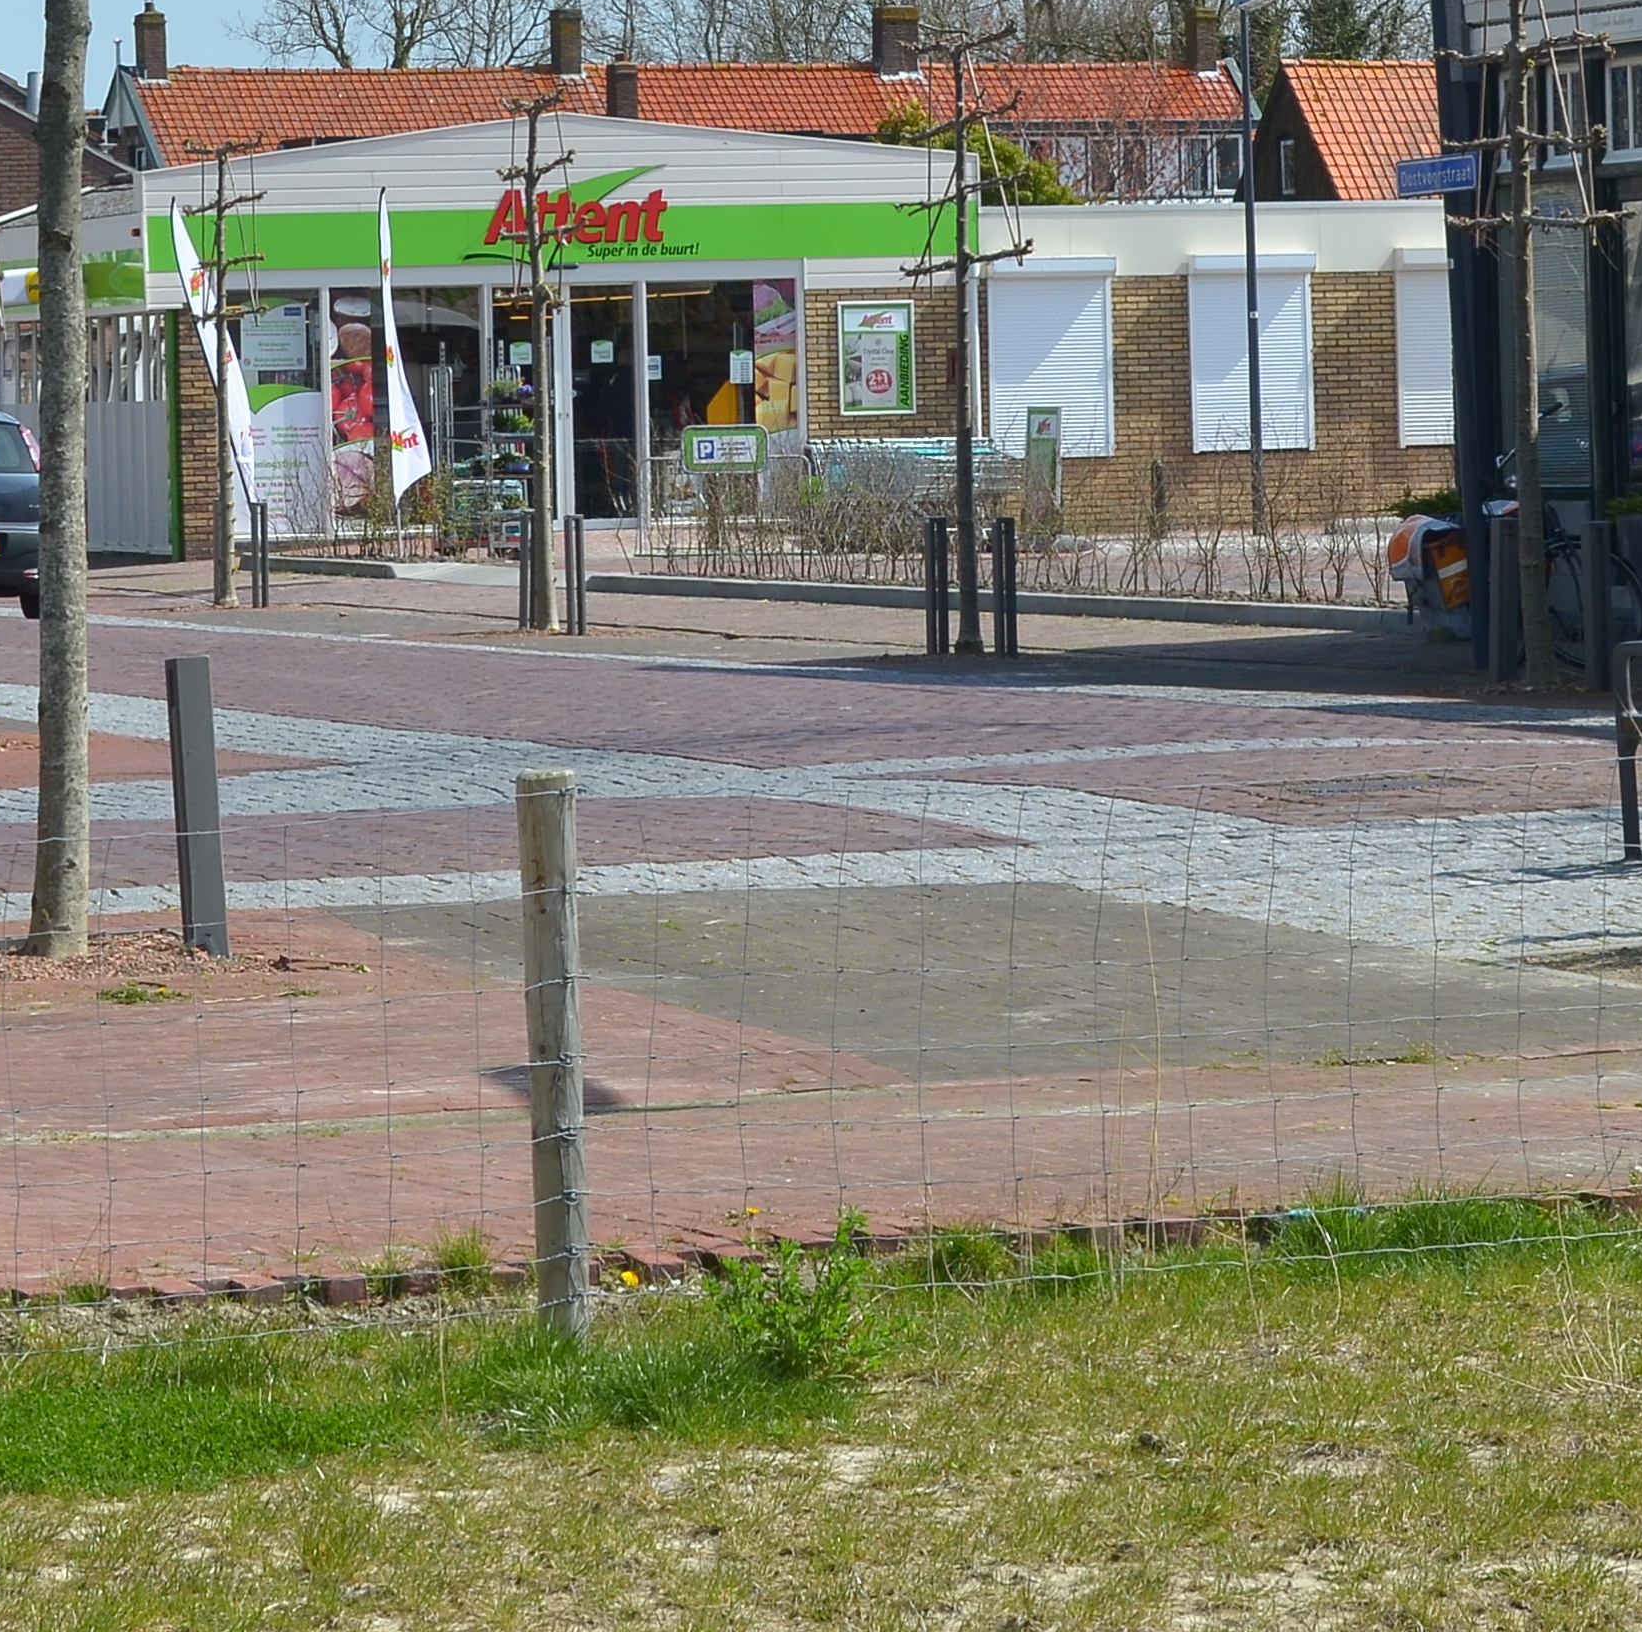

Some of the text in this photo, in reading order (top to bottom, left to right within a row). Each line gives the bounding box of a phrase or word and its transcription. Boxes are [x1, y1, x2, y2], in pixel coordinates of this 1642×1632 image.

[1400, 165, 1472, 187] Oostvoorstraat
[484, 189, 668, 244] Attent
[587, 242, 700, 259] Super in de buurt!
[28, 284, 41, 293] po
[868, 371, 888, 385] 2+1
[899, 334, 910, 406] AANBIEDING
